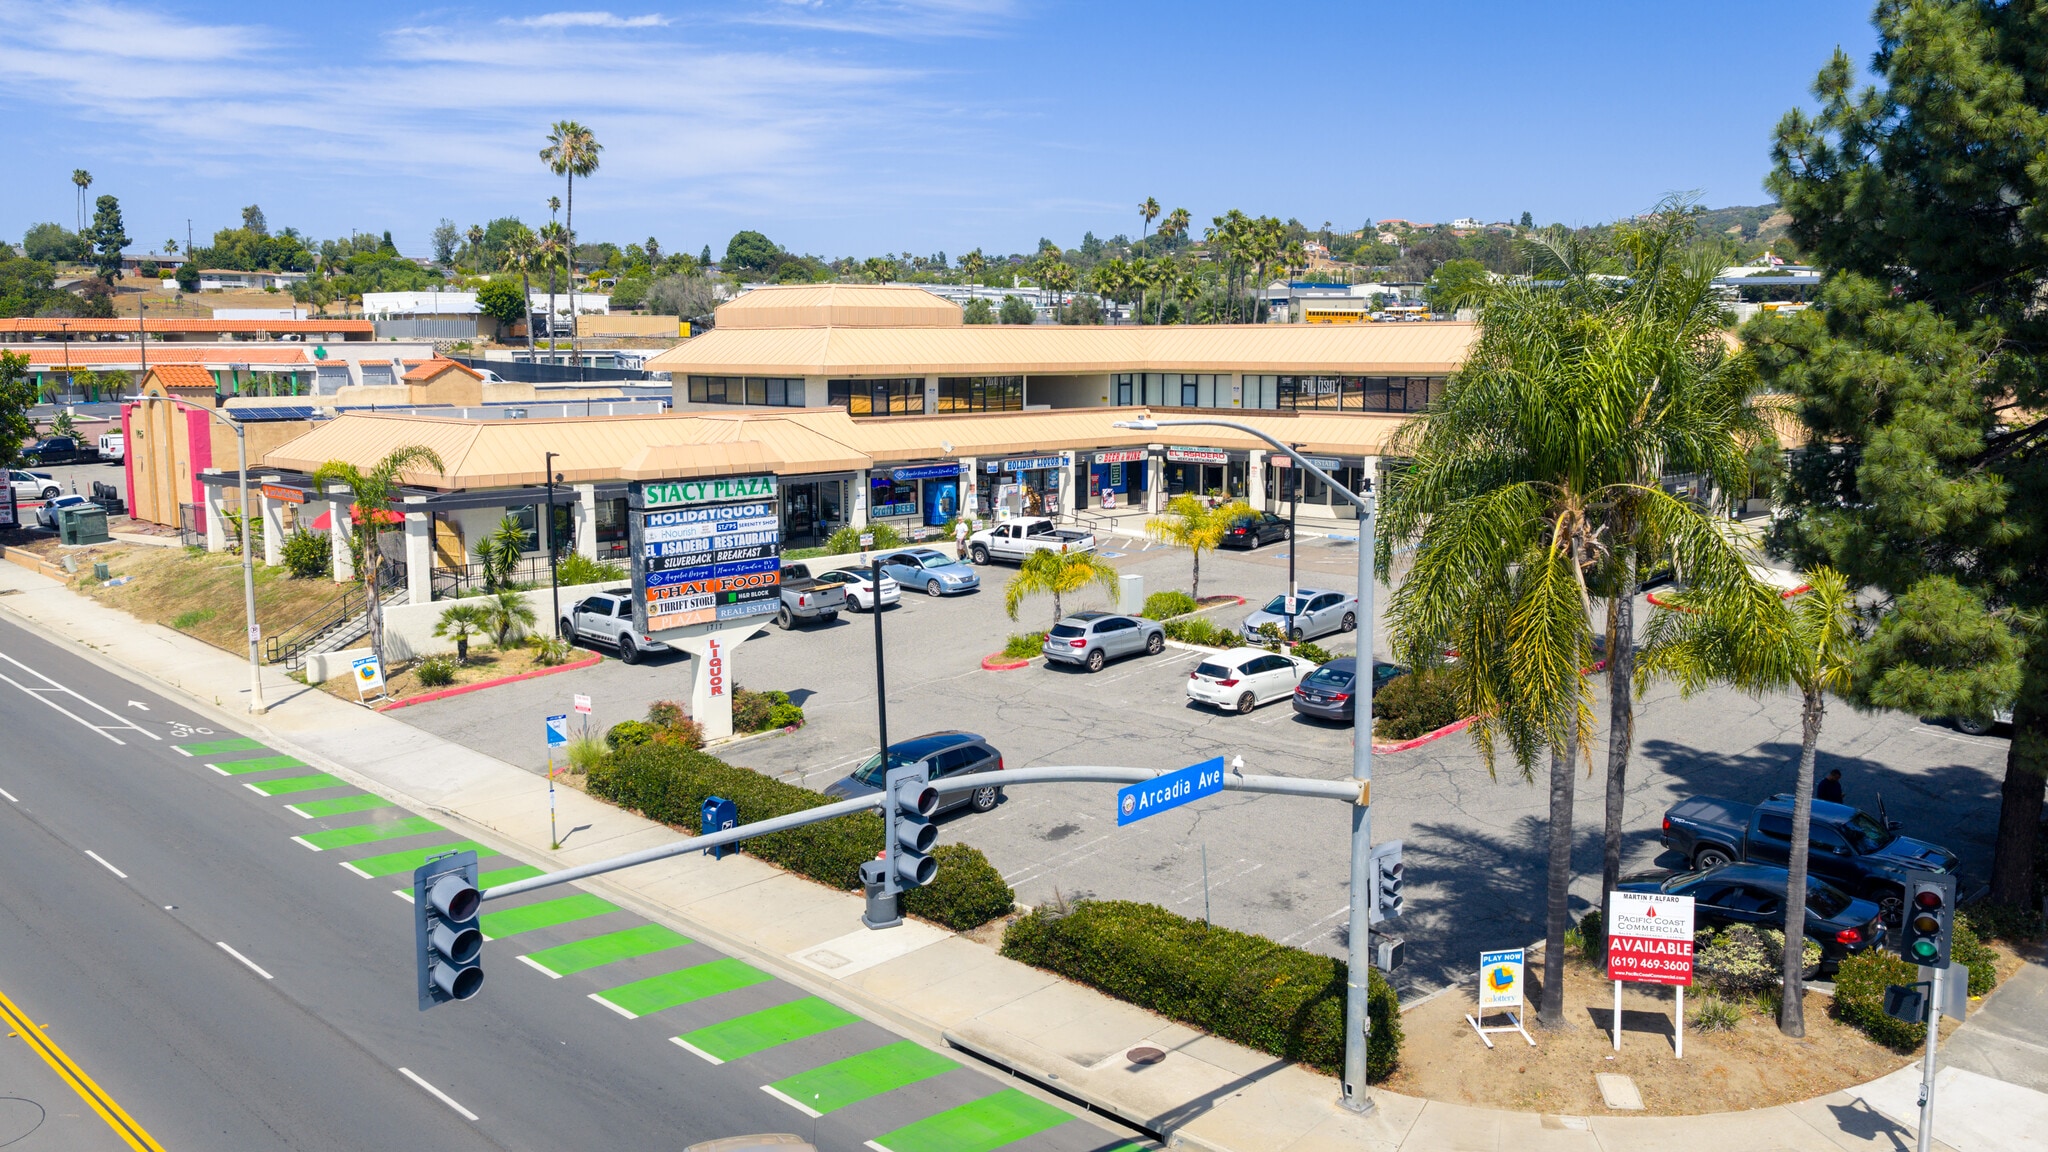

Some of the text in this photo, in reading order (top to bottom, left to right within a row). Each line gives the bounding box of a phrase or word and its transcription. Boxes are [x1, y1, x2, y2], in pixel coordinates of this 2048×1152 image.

[1103, 452, 1120, 462] BEER
[1126, 450, 1141, 460] WINE
[1184, 451, 1225, 459] ASADERO
[1007, 459, 1035, 470] HOLIDAY
[1037, 457, 1059, 467] LIQUOR
[647, 478, 773, 504] STACY PLAZA
[872, 504, 915, 517] Craft BEER
[645, 531, 778, 557] EL ASADERO RESTAURANT
[664, 547, 762, 568] SILVERBACK BREAKFAST
[654, 573, 776, 599] THAI FOOD
[660, 595, 715, 613] THRIFT STORE
[721, 603, 778, 617] REAL ESTATE
[662, 613, 701, 628] PLAZA
[707, 623, 723, 631] 1717
[709, 640, 723, 695] LIQUOR
[1139, 770, 1220, 810] Arcadia Ave
[1618, 922, 1685, 934] COMMERCIAL
[1610, 938, 1692, 956] AVAILABLE
[1504, 952, 1521, 961] NOW
[1611, 956, 1690, 971] (619) 469-3600
